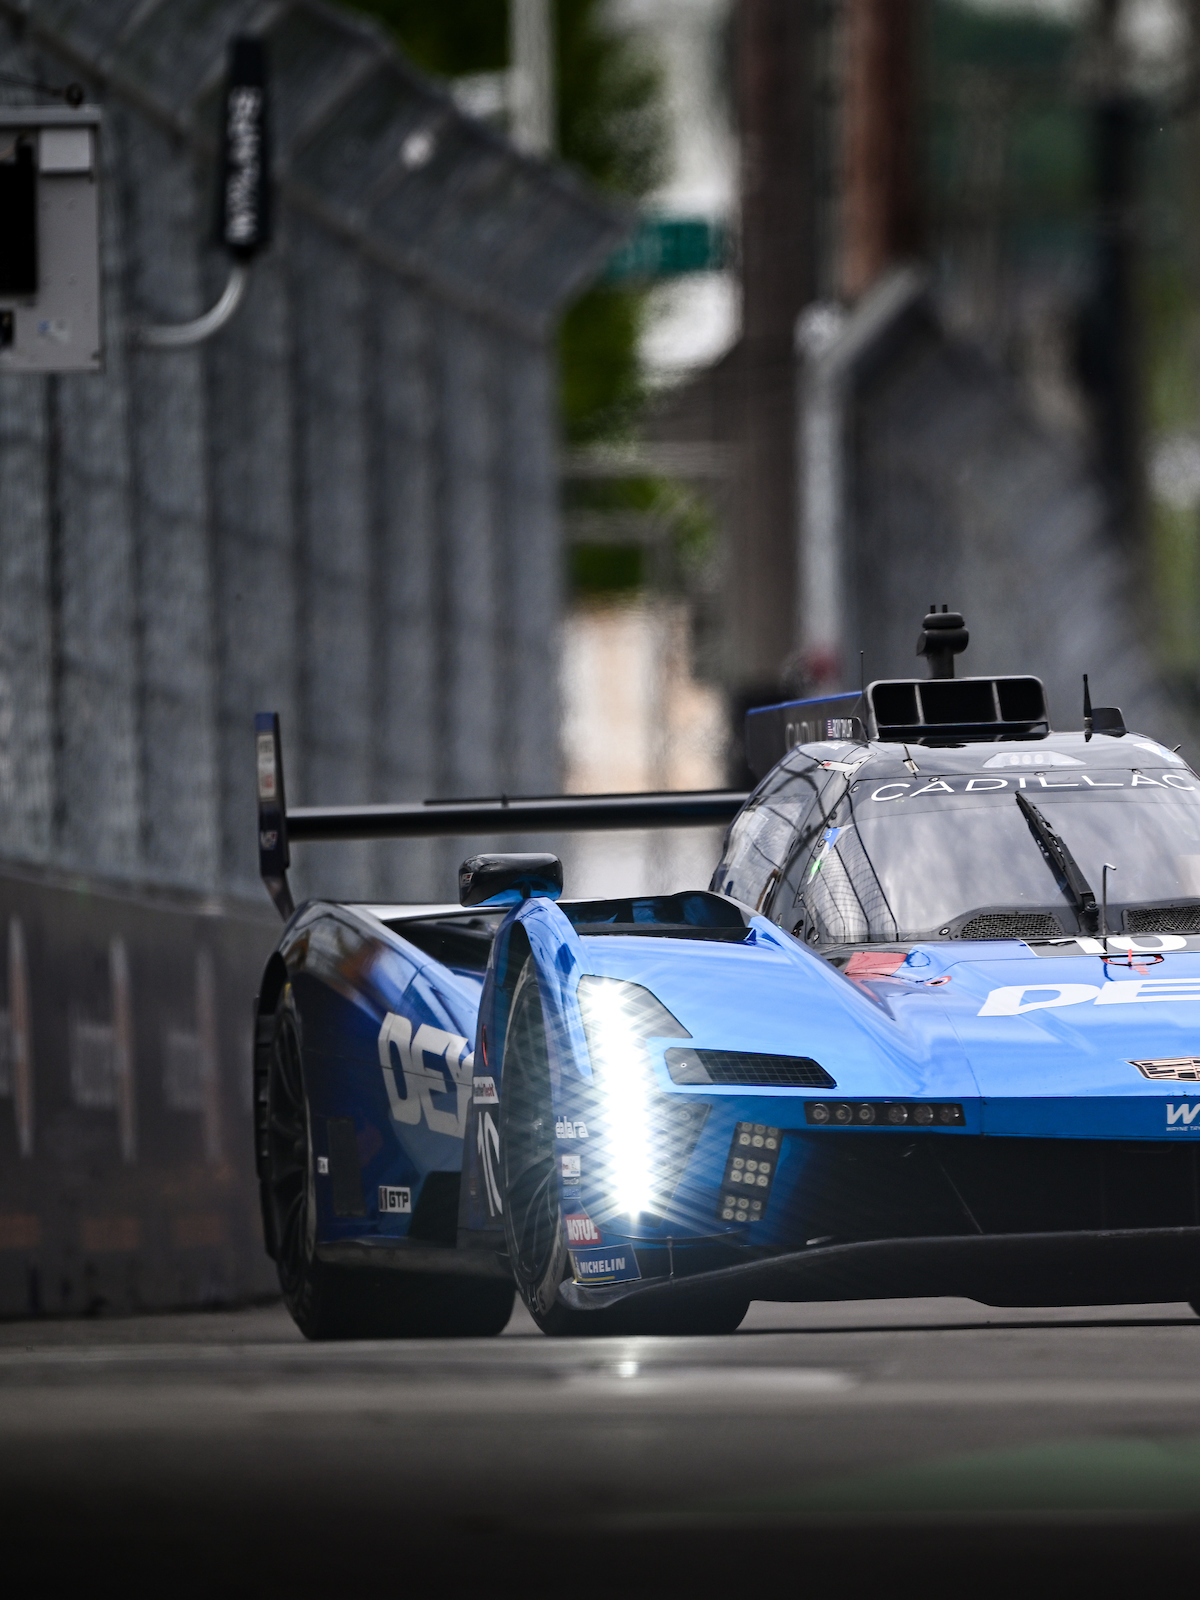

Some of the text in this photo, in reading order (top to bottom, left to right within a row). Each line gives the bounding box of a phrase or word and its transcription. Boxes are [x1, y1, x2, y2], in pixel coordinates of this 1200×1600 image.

[870, 774, 1196, 801] CADILLAC
[388, 1190, 409, 1208] GTP
[566, 1218, 599, 1241] MOTUL
[580, 1257, 626, 1274] MICHELIN
